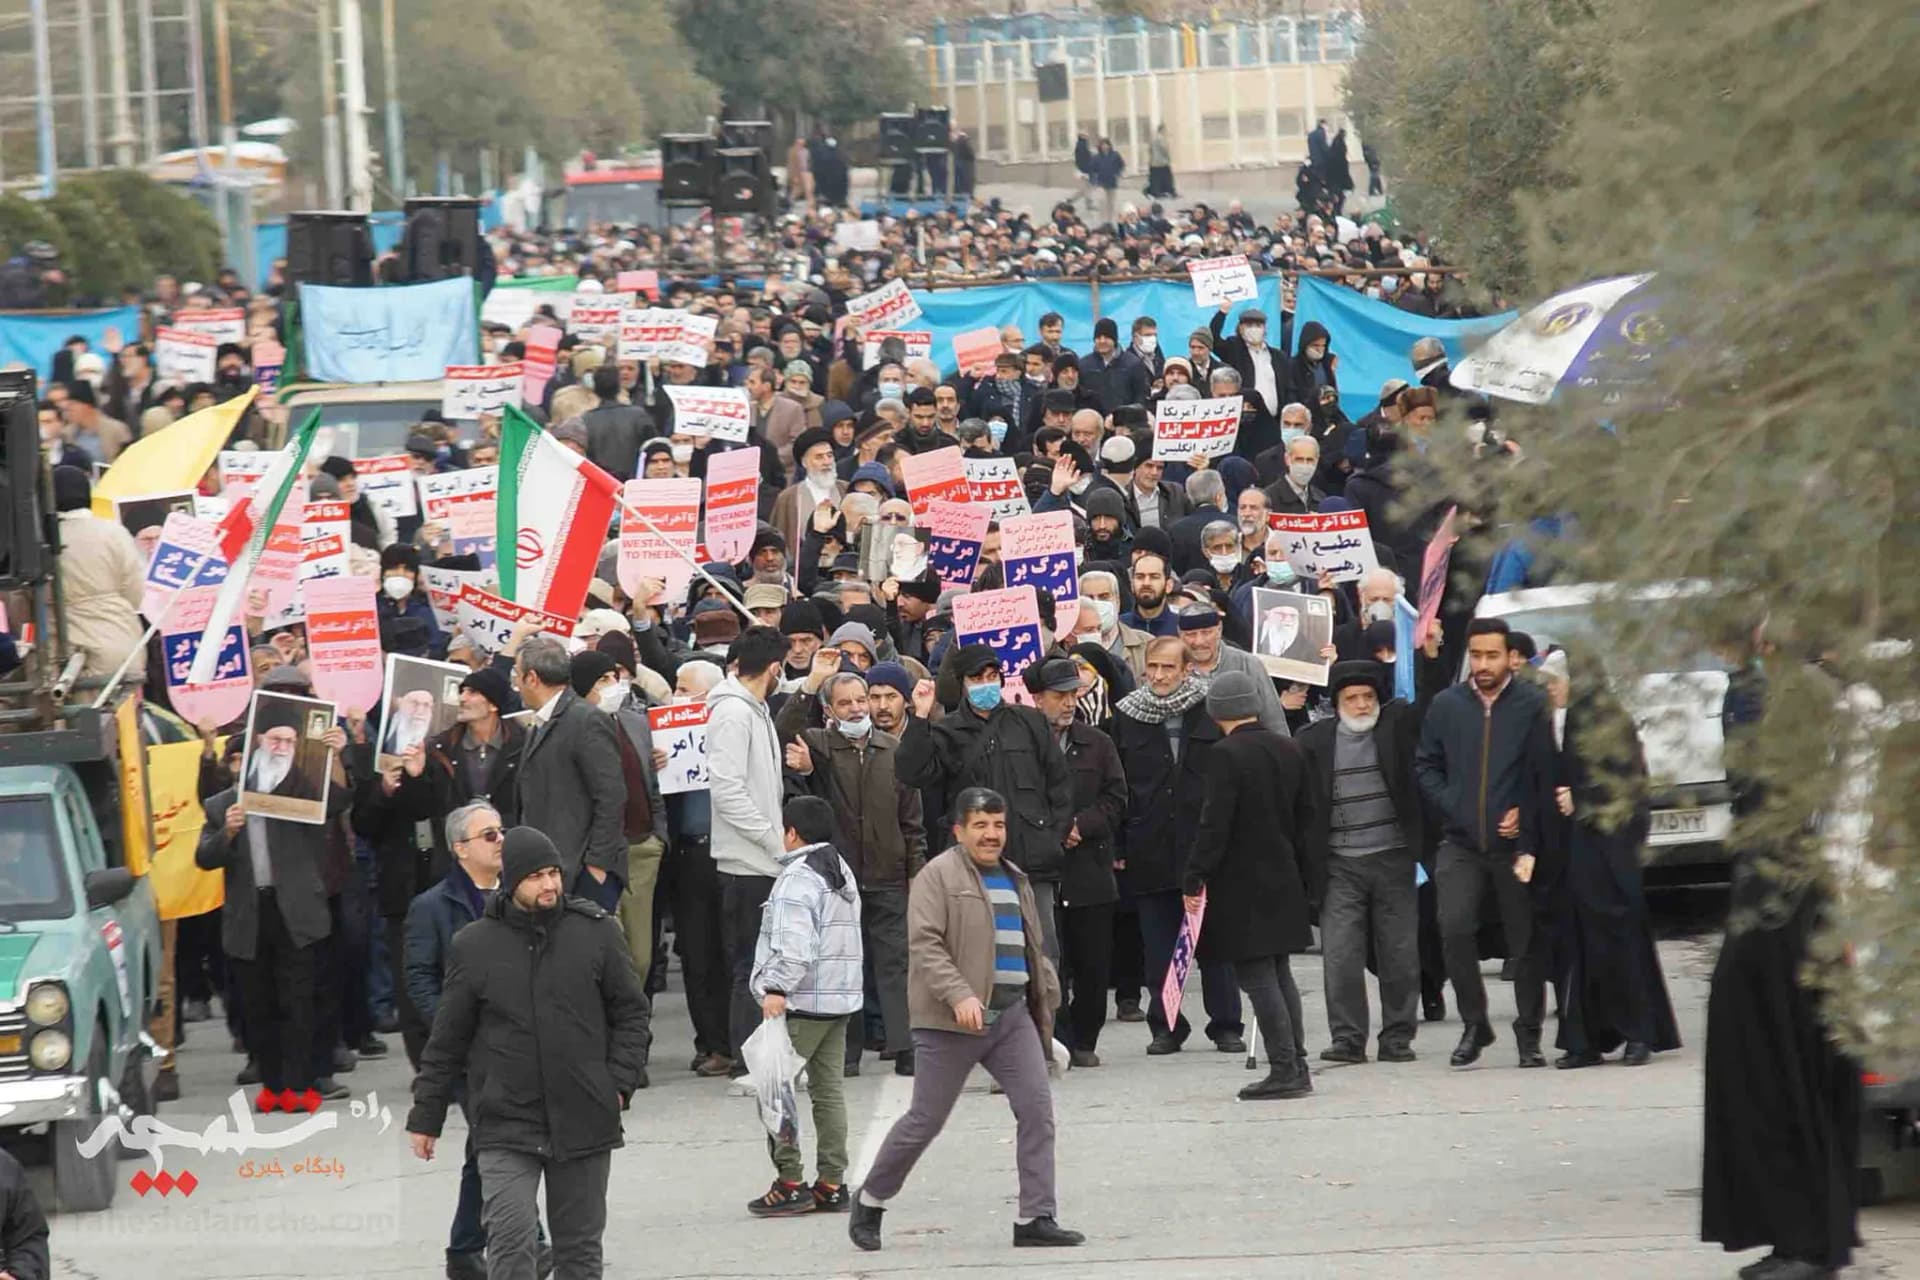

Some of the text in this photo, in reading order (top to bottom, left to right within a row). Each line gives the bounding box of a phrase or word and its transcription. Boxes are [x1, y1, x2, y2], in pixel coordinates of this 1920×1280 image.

[1201, 408, 1211, 420] بر
[1213, 404, 1236, 417] مرگ
[1202, 424, 1213, 438] بر
[1213, 420, 1236, 436] مرگ
[1211, 439, 1230, 452] مرگ
[988, 465, 1012, 479] مرگ
[984, 488, 994, 501] بر
[994, 483, 1021, 499] مرگ
[1000, 503, 1026, 515] مرگ
[1339, 515, 1350, 525] تا
[1350, 514, 1361, 524] ما
[940, 540, 974, 560] مرگ
[1012, 556, 1069, 582] مرگ بر
[468, 619, 496, 633] امر
[988, 628, 1032, 650] مرگ
[670, 730, 694, 759] امر
